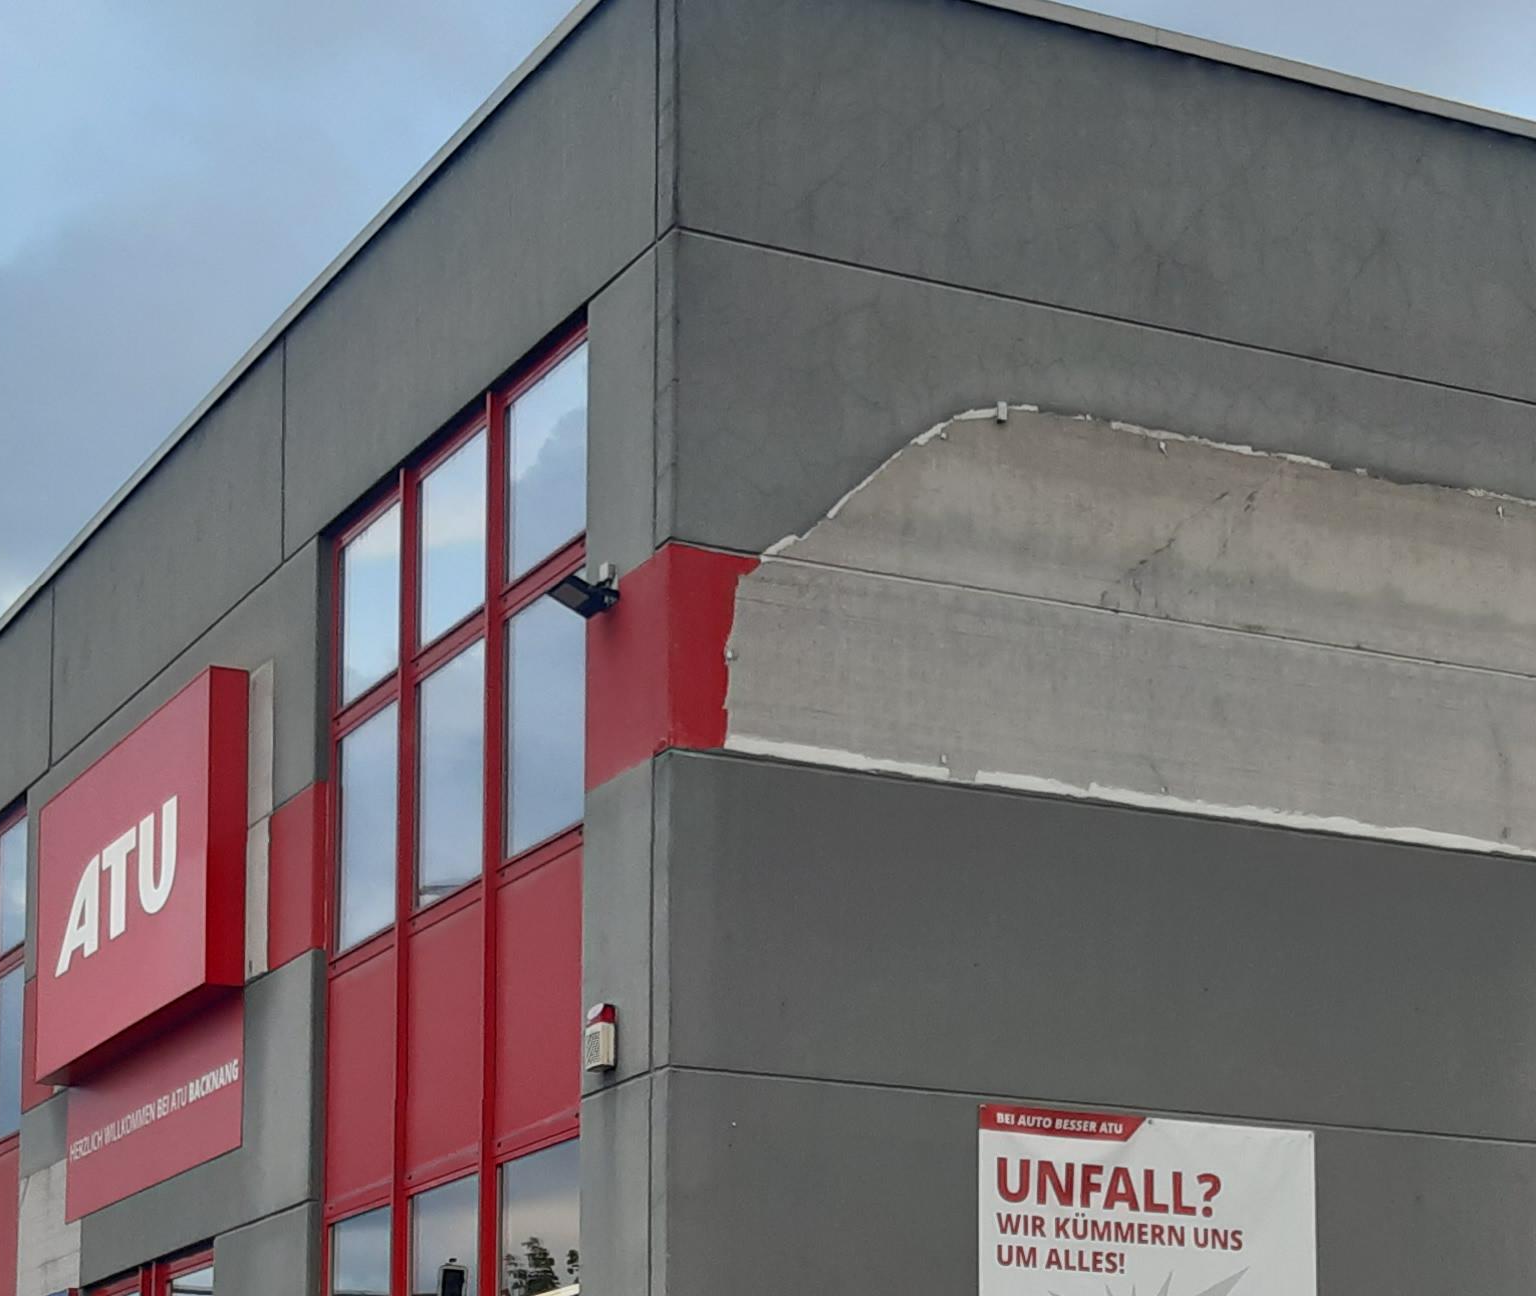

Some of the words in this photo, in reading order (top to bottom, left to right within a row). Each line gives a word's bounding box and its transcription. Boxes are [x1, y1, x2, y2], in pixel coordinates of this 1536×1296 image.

[55, 795, 178, 978] ATU
[69, 1127, 103, 1161] HERZLICH
[104, 1102, 156, 1145] WILLKOMMEN
[157, 1098, 170, 1120] BEI
[170, 1085, 187, 1112] ATU
[188, 1059, 240, 1103] BACKNANG
[996, 1112, 1015, 1125] BEI
[1017, 1114, 1051, 1128] AUTO
[1055, 1117, 1097, 1132] BESSER
[1099, 1120, 1124, 1134] ATU
[996, 1157, 1222, 1218] UNFALL?
[996, 1213, 1046, 1237] WIR
[1055, 1213, 1185, 1247] KÜMMERN
[1194, 1228, 1243, 1251] UNS
[996, 1245, 1037, 1268] UM
[1045, 1249, 1125, 1274] ALLES!
